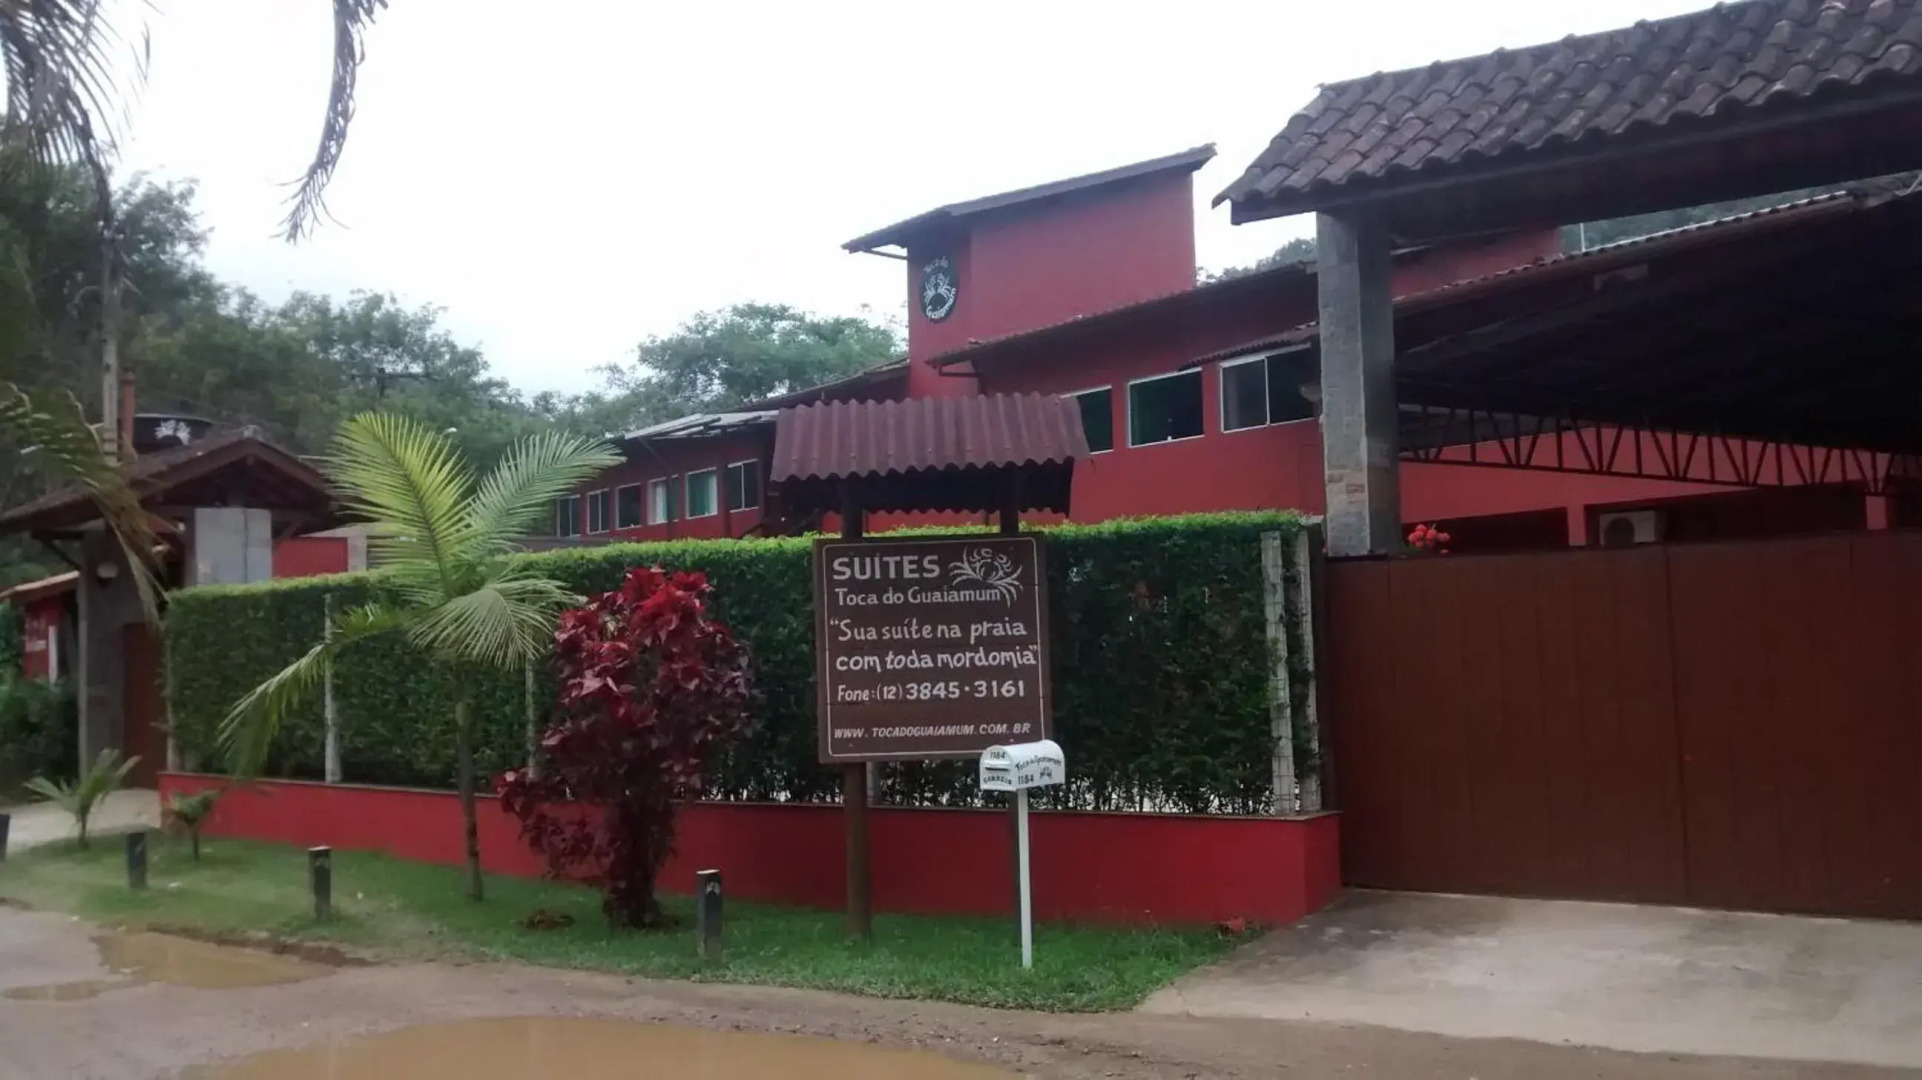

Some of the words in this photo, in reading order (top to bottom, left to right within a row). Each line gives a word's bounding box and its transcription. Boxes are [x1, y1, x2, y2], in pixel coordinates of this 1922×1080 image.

[834, 588, 879, 606] Toca
[882, 586, 904, 605] do
[907, 585, 1001, 604] Guaiamum
[881, 617, 933, 639] suíte
[937, 624, 962, 639] na
[970, 616, 1027, 645] praia
[836, 655, 881, 673] com
[885, 649, 934, 669] toda
[990, 751, 1006, 759] 1184
